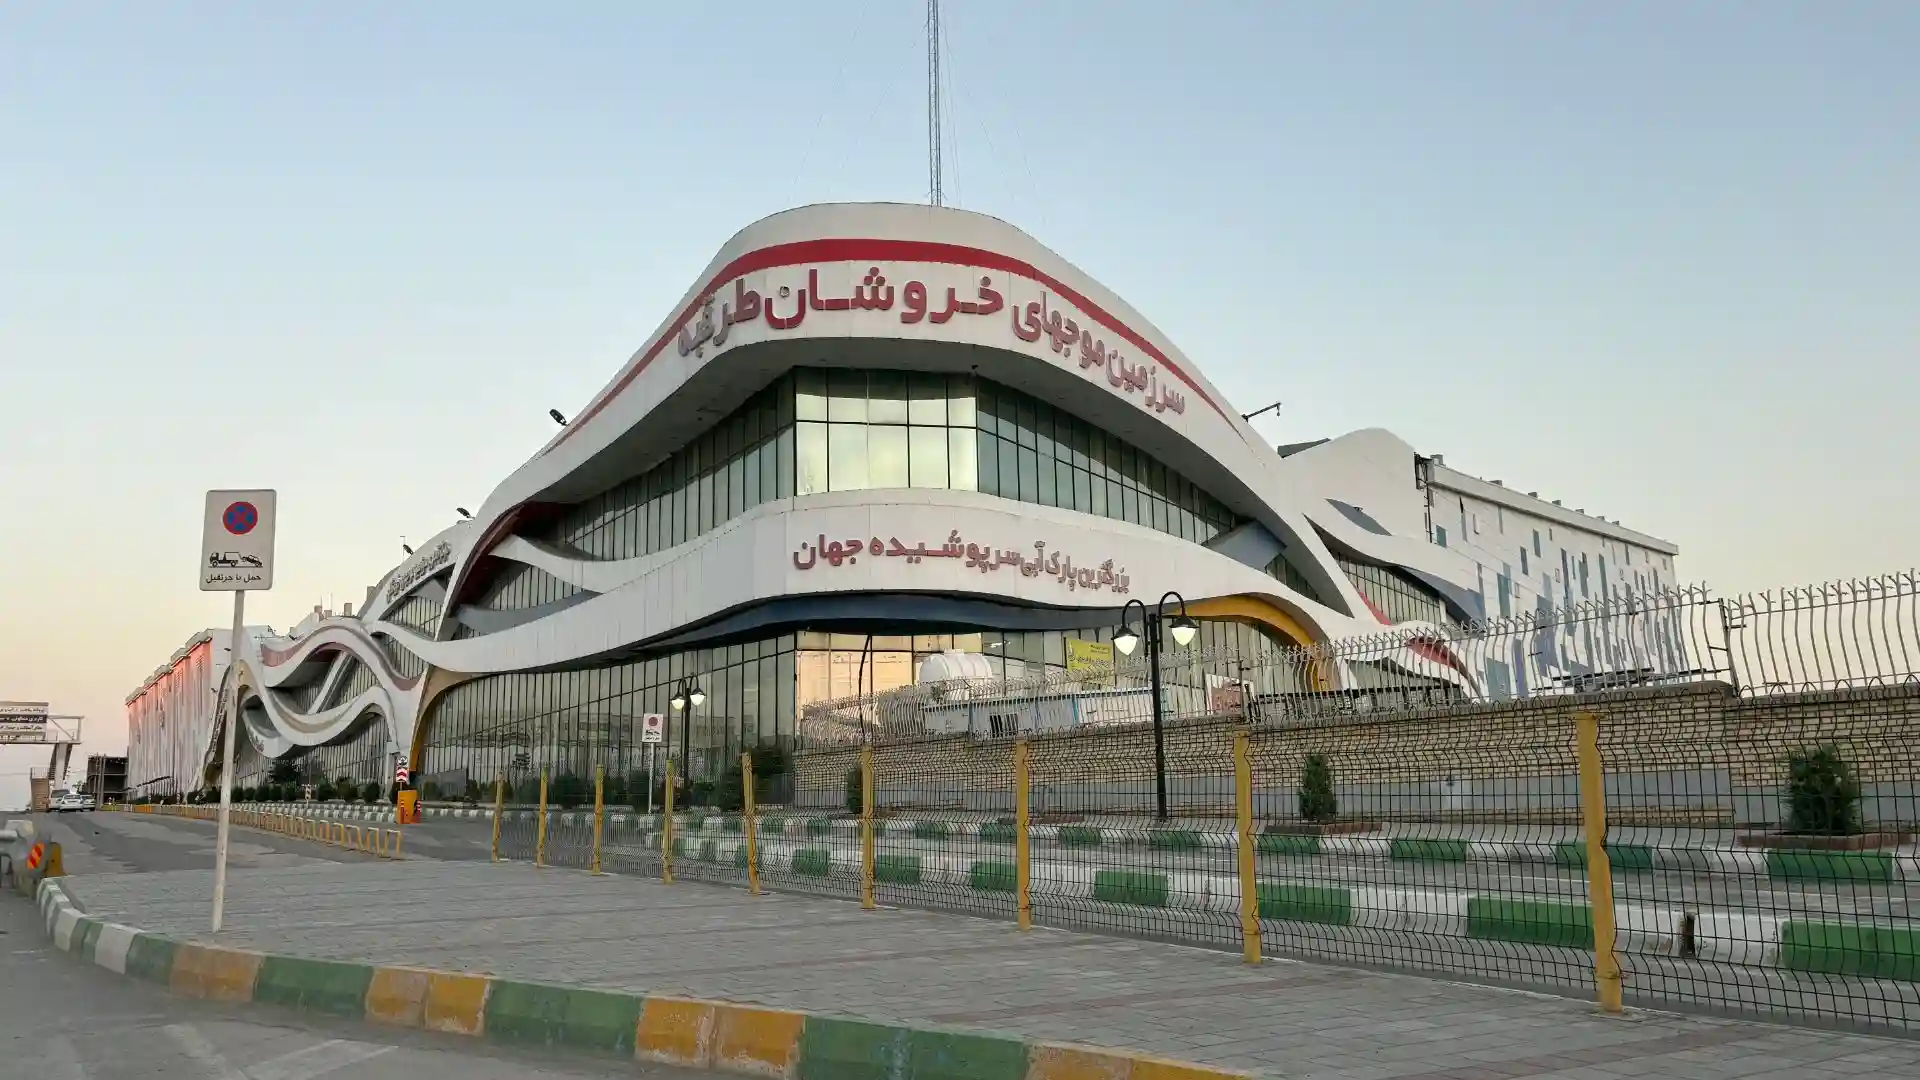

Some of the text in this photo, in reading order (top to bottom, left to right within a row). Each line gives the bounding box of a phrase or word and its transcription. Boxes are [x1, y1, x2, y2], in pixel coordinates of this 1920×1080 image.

[677, 265, 1186, 415] سرزمین موجهای خروشان طرقبه
[793, 533, 864, 571] جهان
[1020, 540, 1046, 578] آبی
[1044, 550, 1078, 592] پارک
[235, 573, 242, 583] با
[243, 573, 261, 583] حمل
[1077, 558, 1130, 594] بزرگترین
